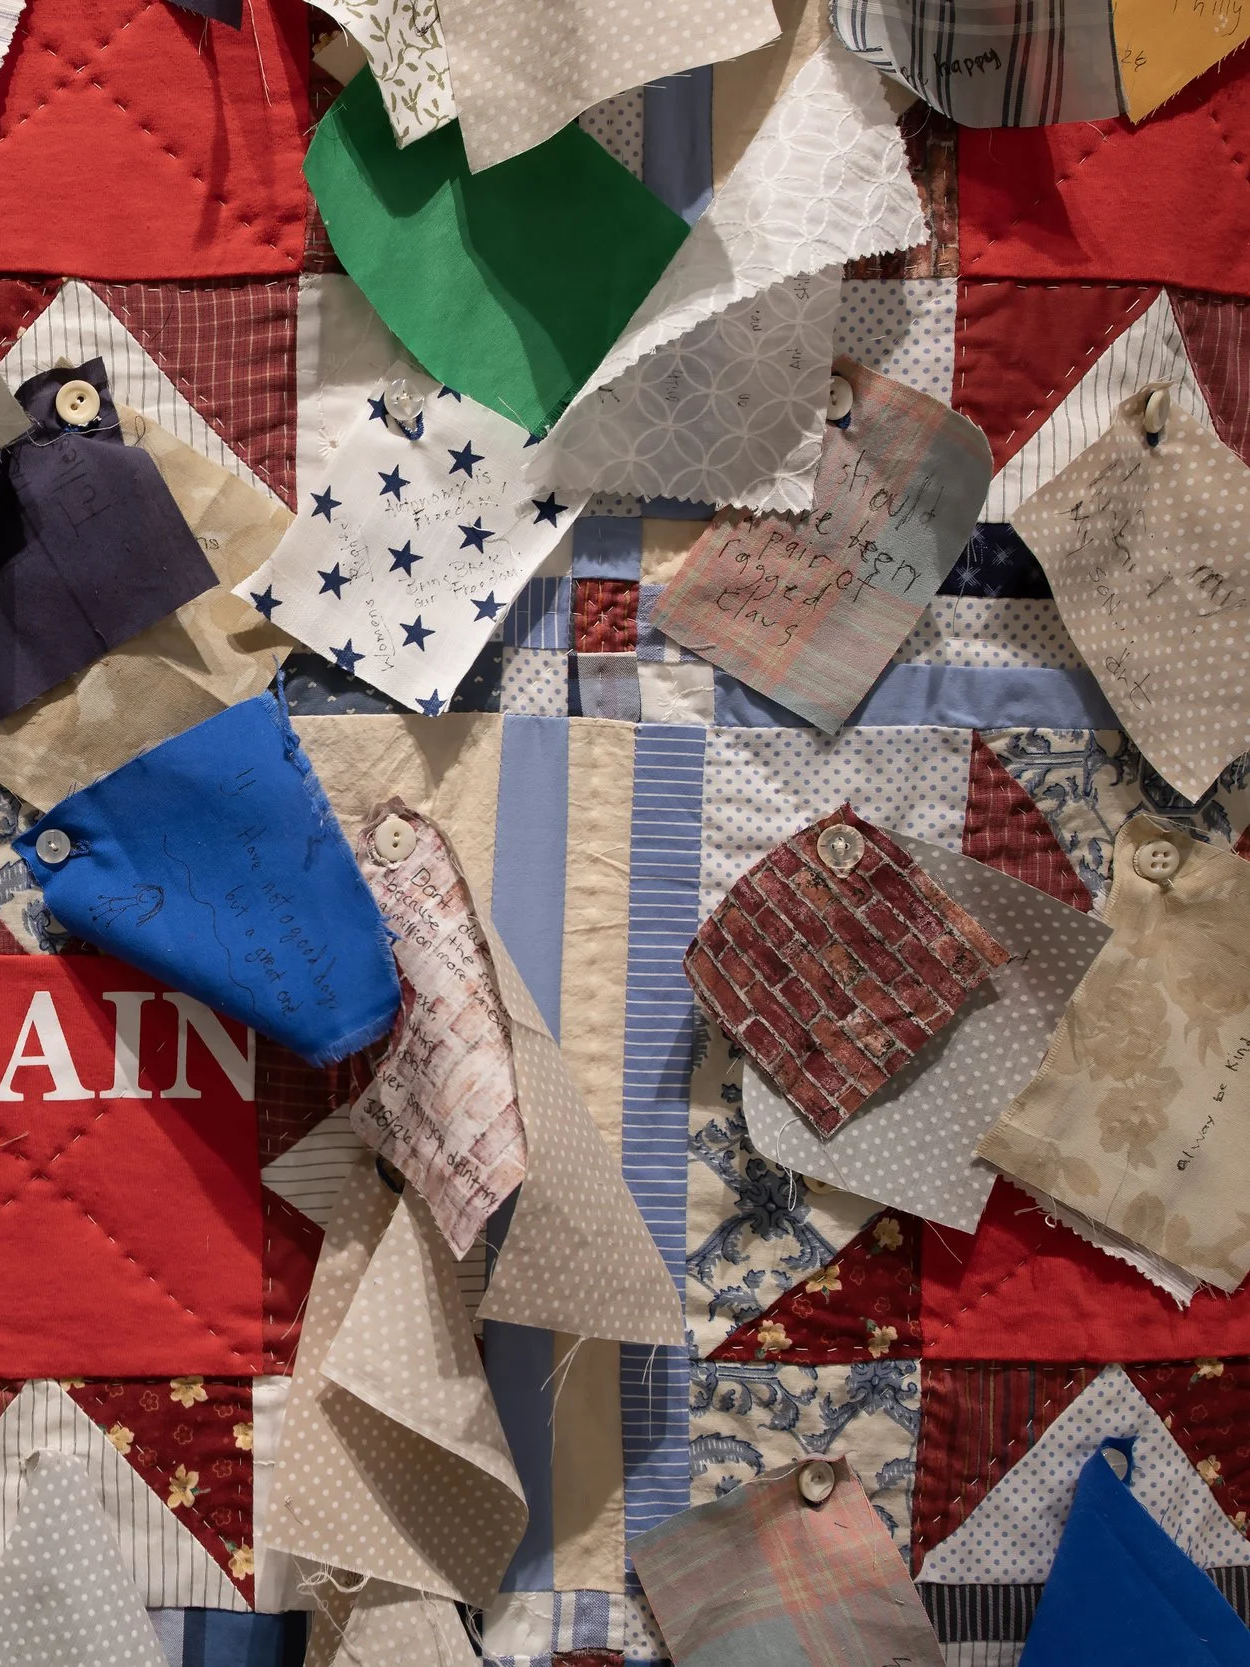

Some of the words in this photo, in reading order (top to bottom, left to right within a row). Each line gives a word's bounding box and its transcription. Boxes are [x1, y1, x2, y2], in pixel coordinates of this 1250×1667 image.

[933, 49, 1002, 79] happy
[758, 531, 831, 569] pair
[386, 877, 440, 932] because
[449, 935, 475, 966] the
[392, 913, 432, 951] million
[436, 951, 467, 982] more
